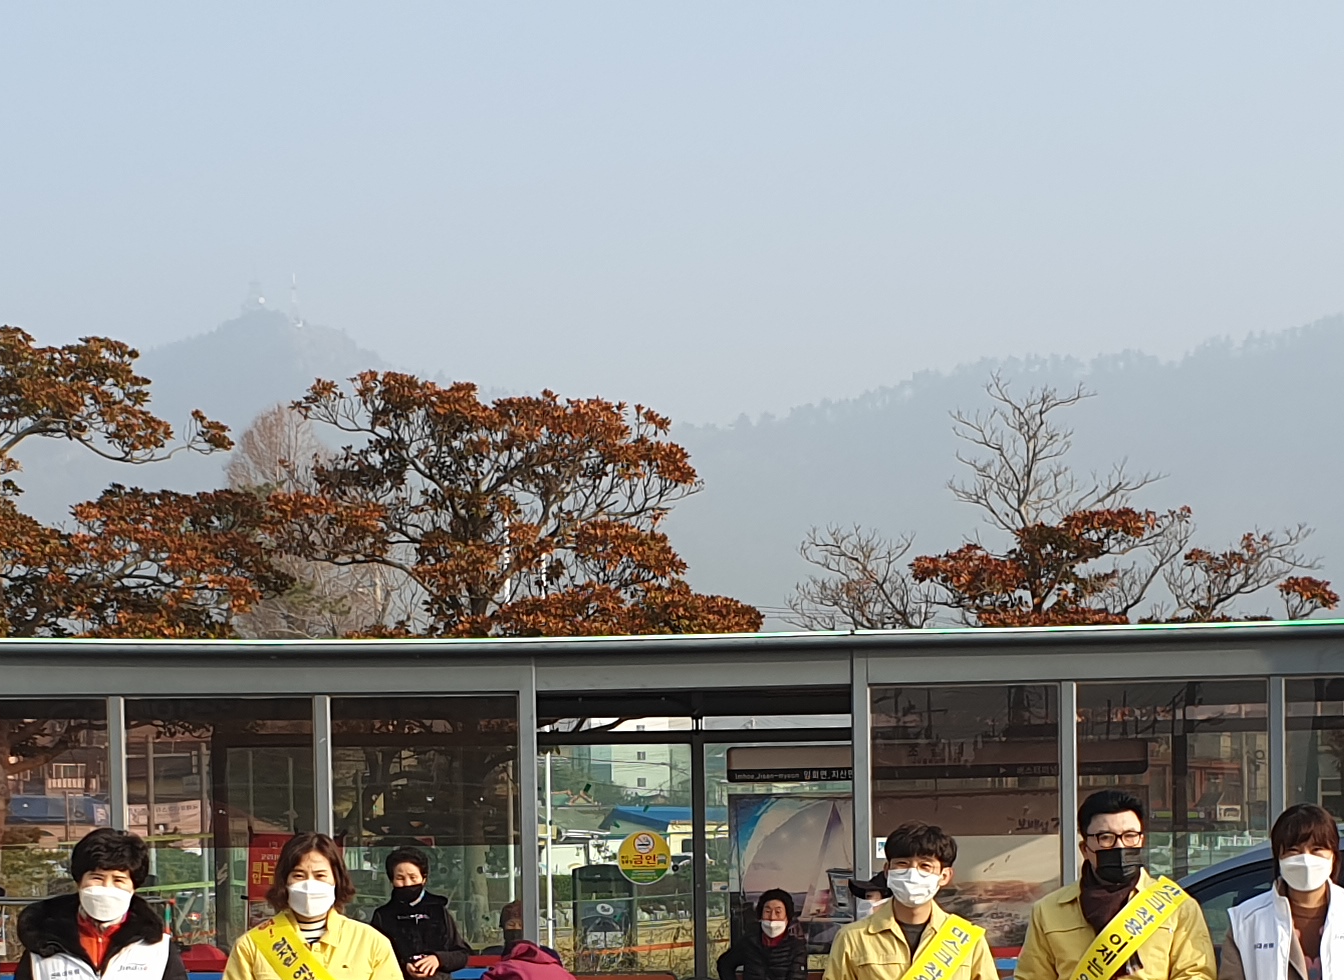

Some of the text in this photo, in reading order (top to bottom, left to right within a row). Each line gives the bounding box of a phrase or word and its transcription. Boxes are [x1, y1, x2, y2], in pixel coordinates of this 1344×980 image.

[1145, 884, 1182, 914] 마스크
[933, 927, 970, 968] 마스크
[1087, 933, 1129, 979] 이제는
